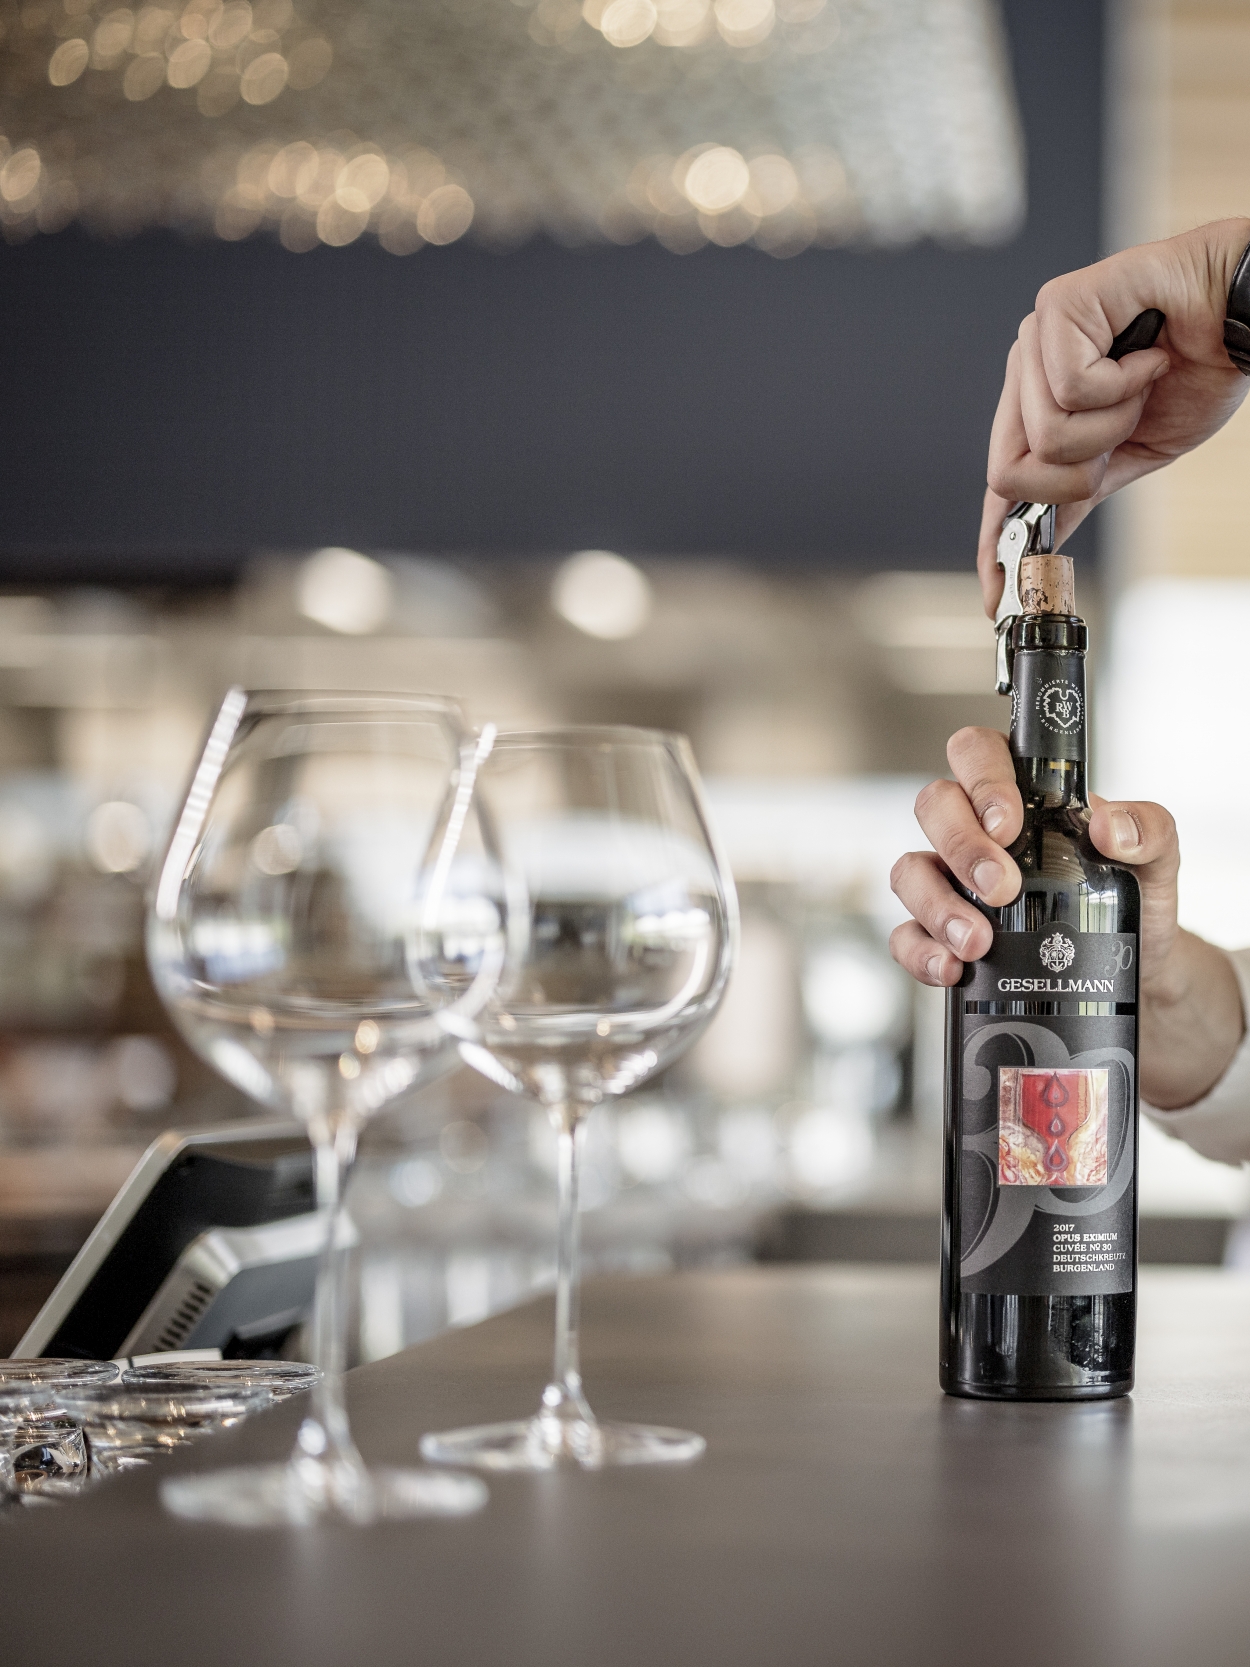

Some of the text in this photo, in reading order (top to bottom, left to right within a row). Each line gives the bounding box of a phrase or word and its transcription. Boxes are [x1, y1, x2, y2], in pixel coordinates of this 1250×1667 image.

[1104, 940, 1133, 977] 30
[997, 978, 1114, 993] GESELLMANN
[1053, 1224, 1075, 1232] 2017
[1053, 1232, 1118, 1242] OPUS EXIMIUM
[1053, 1242, 1087, 1252] CUVÉE
[1102, 1243, 1112, 1251] 30
[1053, 1263, 1115, 1272] BURGENLAND
